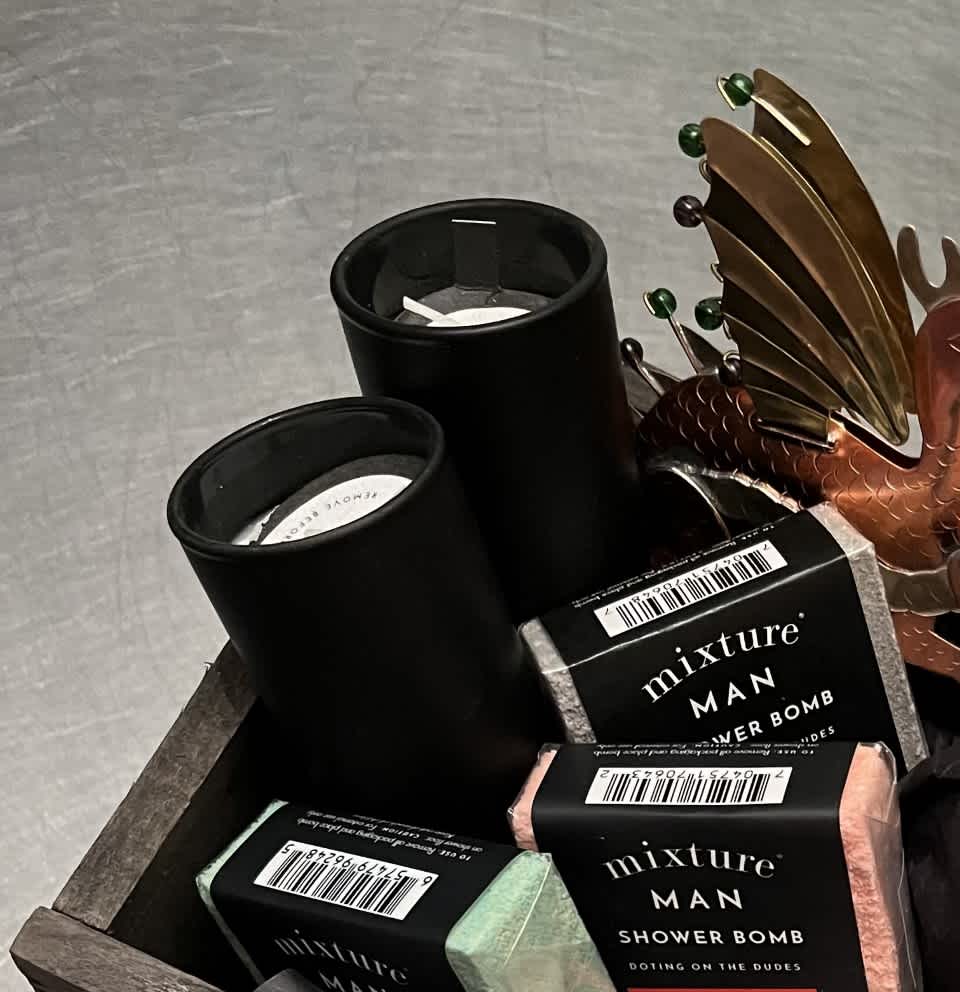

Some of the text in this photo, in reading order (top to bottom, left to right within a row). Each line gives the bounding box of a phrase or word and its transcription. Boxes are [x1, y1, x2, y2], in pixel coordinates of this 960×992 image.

[641, 622, 800, 703] mixture
[689, 667, 775, 719] MAN
[770, 690, 834, 727] BOMB
[600, 769, 611, 779] 2
[631, 769, 687, 780] 70643
[698, 769, 754, 780] 04751
[281, 843, 433, 886] 6 57479 96248 5
[605, 841, 776, 880] mixture
[651, 889, 743, 910] MAN
[619, 930, 804, 945] SHOWER BOMB
[629, 963, 801, 972] DOTING ON THE DUDES
